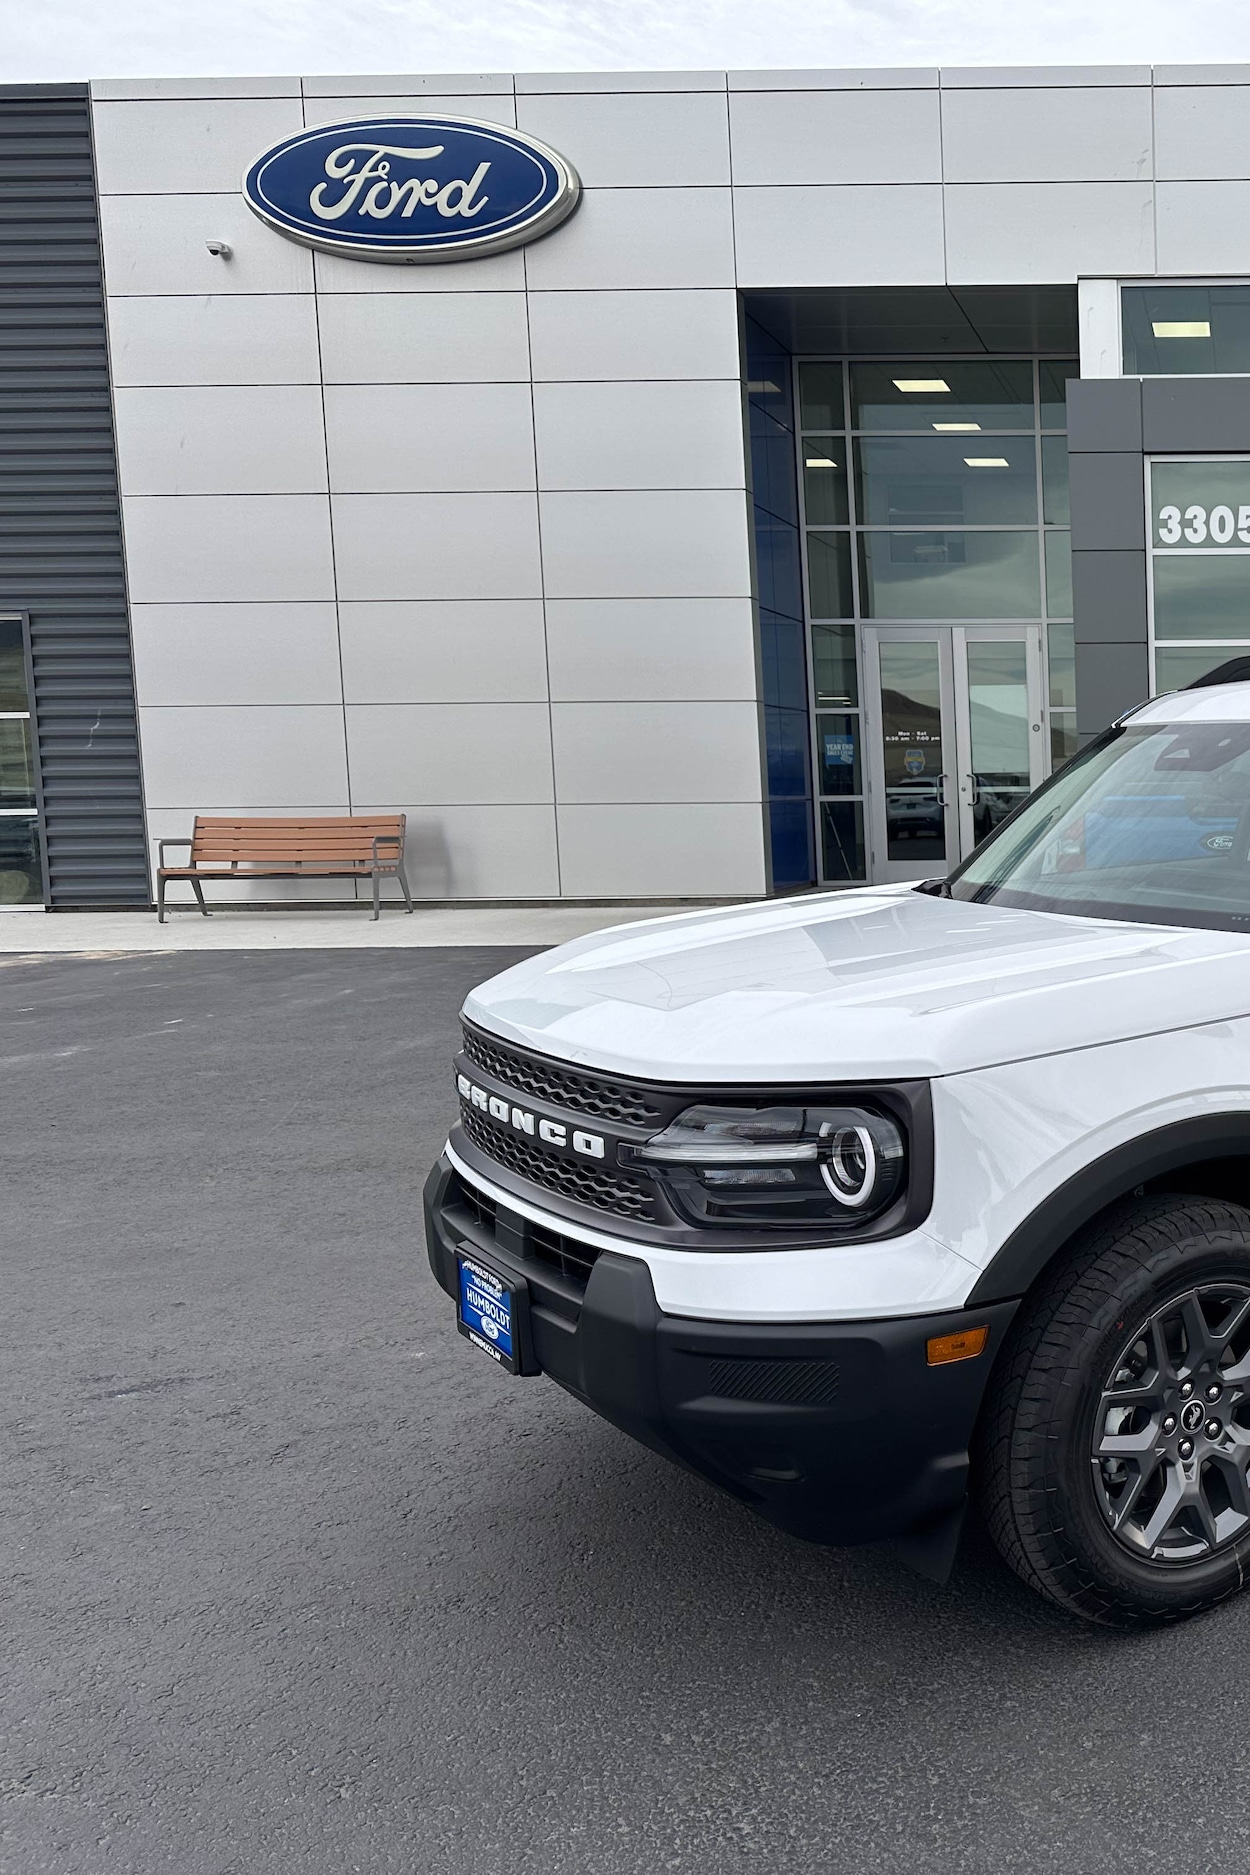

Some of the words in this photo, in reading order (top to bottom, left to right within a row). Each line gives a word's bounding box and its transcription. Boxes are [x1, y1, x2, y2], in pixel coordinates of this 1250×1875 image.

[310, 143, 492, 220] Ford
[457, 1074, 605, 1159] BRONCO
[466, 1287, 510, 1330] HUMBOLDT
